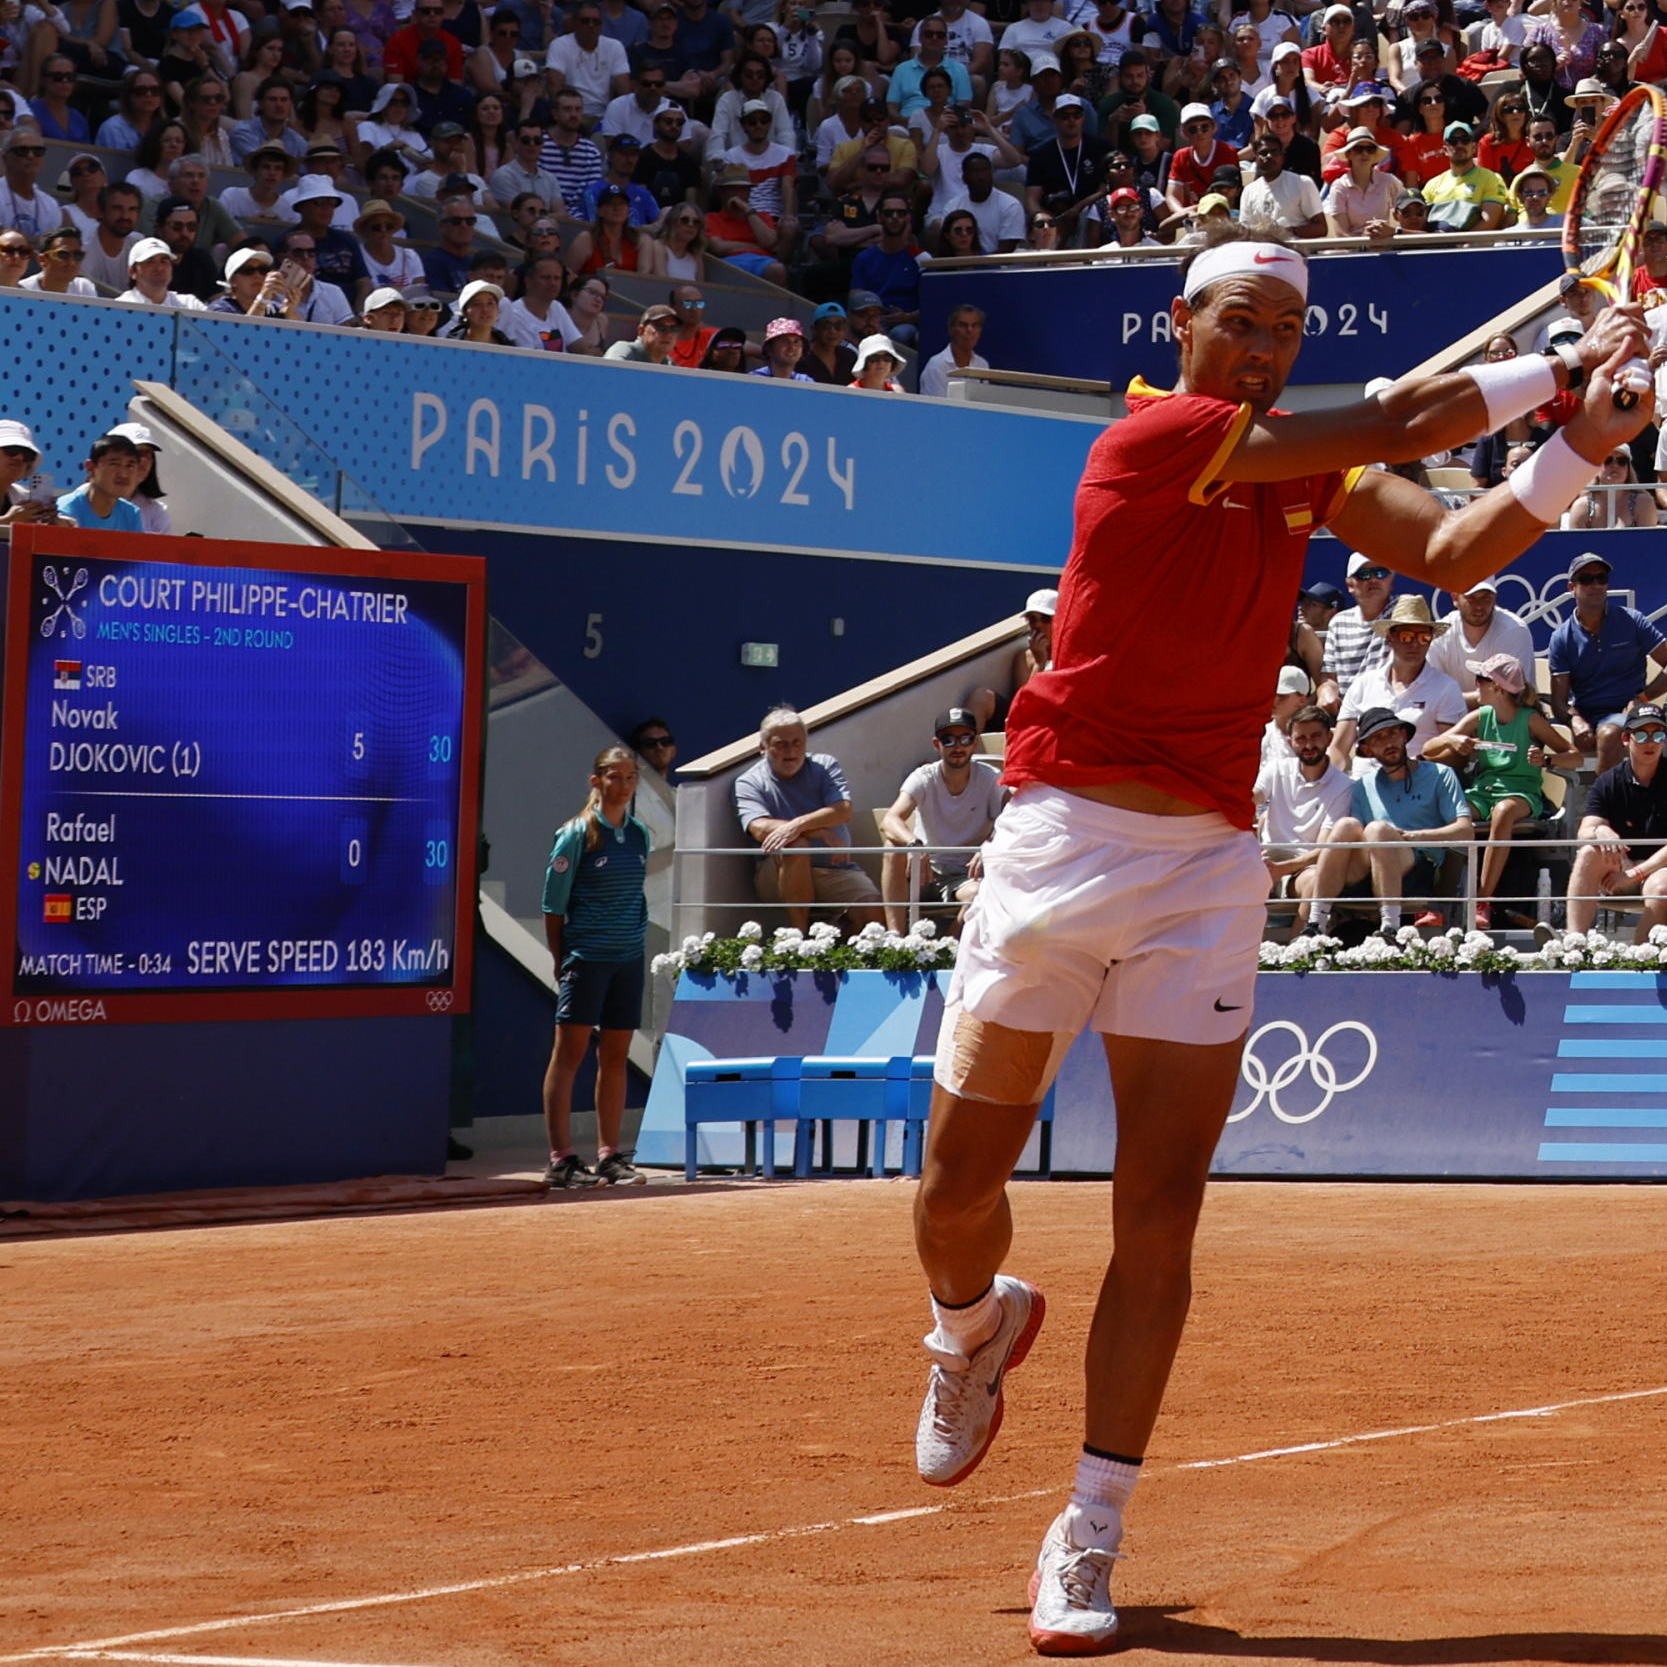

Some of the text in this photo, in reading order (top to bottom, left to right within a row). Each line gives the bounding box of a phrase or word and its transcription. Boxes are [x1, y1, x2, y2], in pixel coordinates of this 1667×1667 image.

[672, 419, 855, 511] 2024
[100, 574, 408, 624] COURT PHILIPPE-CHATRIER
[97, 620, 141, 642] MEN'S
[143, 623, 201, 645] SINGLES
[213, 628, 241, 646] 2ND
[244, 629, 294, 649] ROUND
[584, 613, 602, 659] 5
[86, 665, 117, 689] SRB
[51, 699, 119, 730] Novak
[50, 732, 452, 778] DJOKOVIC (1) 5 30
[46, 812, 117, 843] Rafael
[45, 839, 448, 886] NADAL 0 30
[75, 897, 108, 921] ESP
[18, 953, 81, 976] MATCH
[85, 953, 124, 976] TIME
[138, 953, 172, 975] 0:34
[187, 938, 449, 974] SERVE SPEED 183 Km/h
[36, 999, 107, 1023] OMEGA
